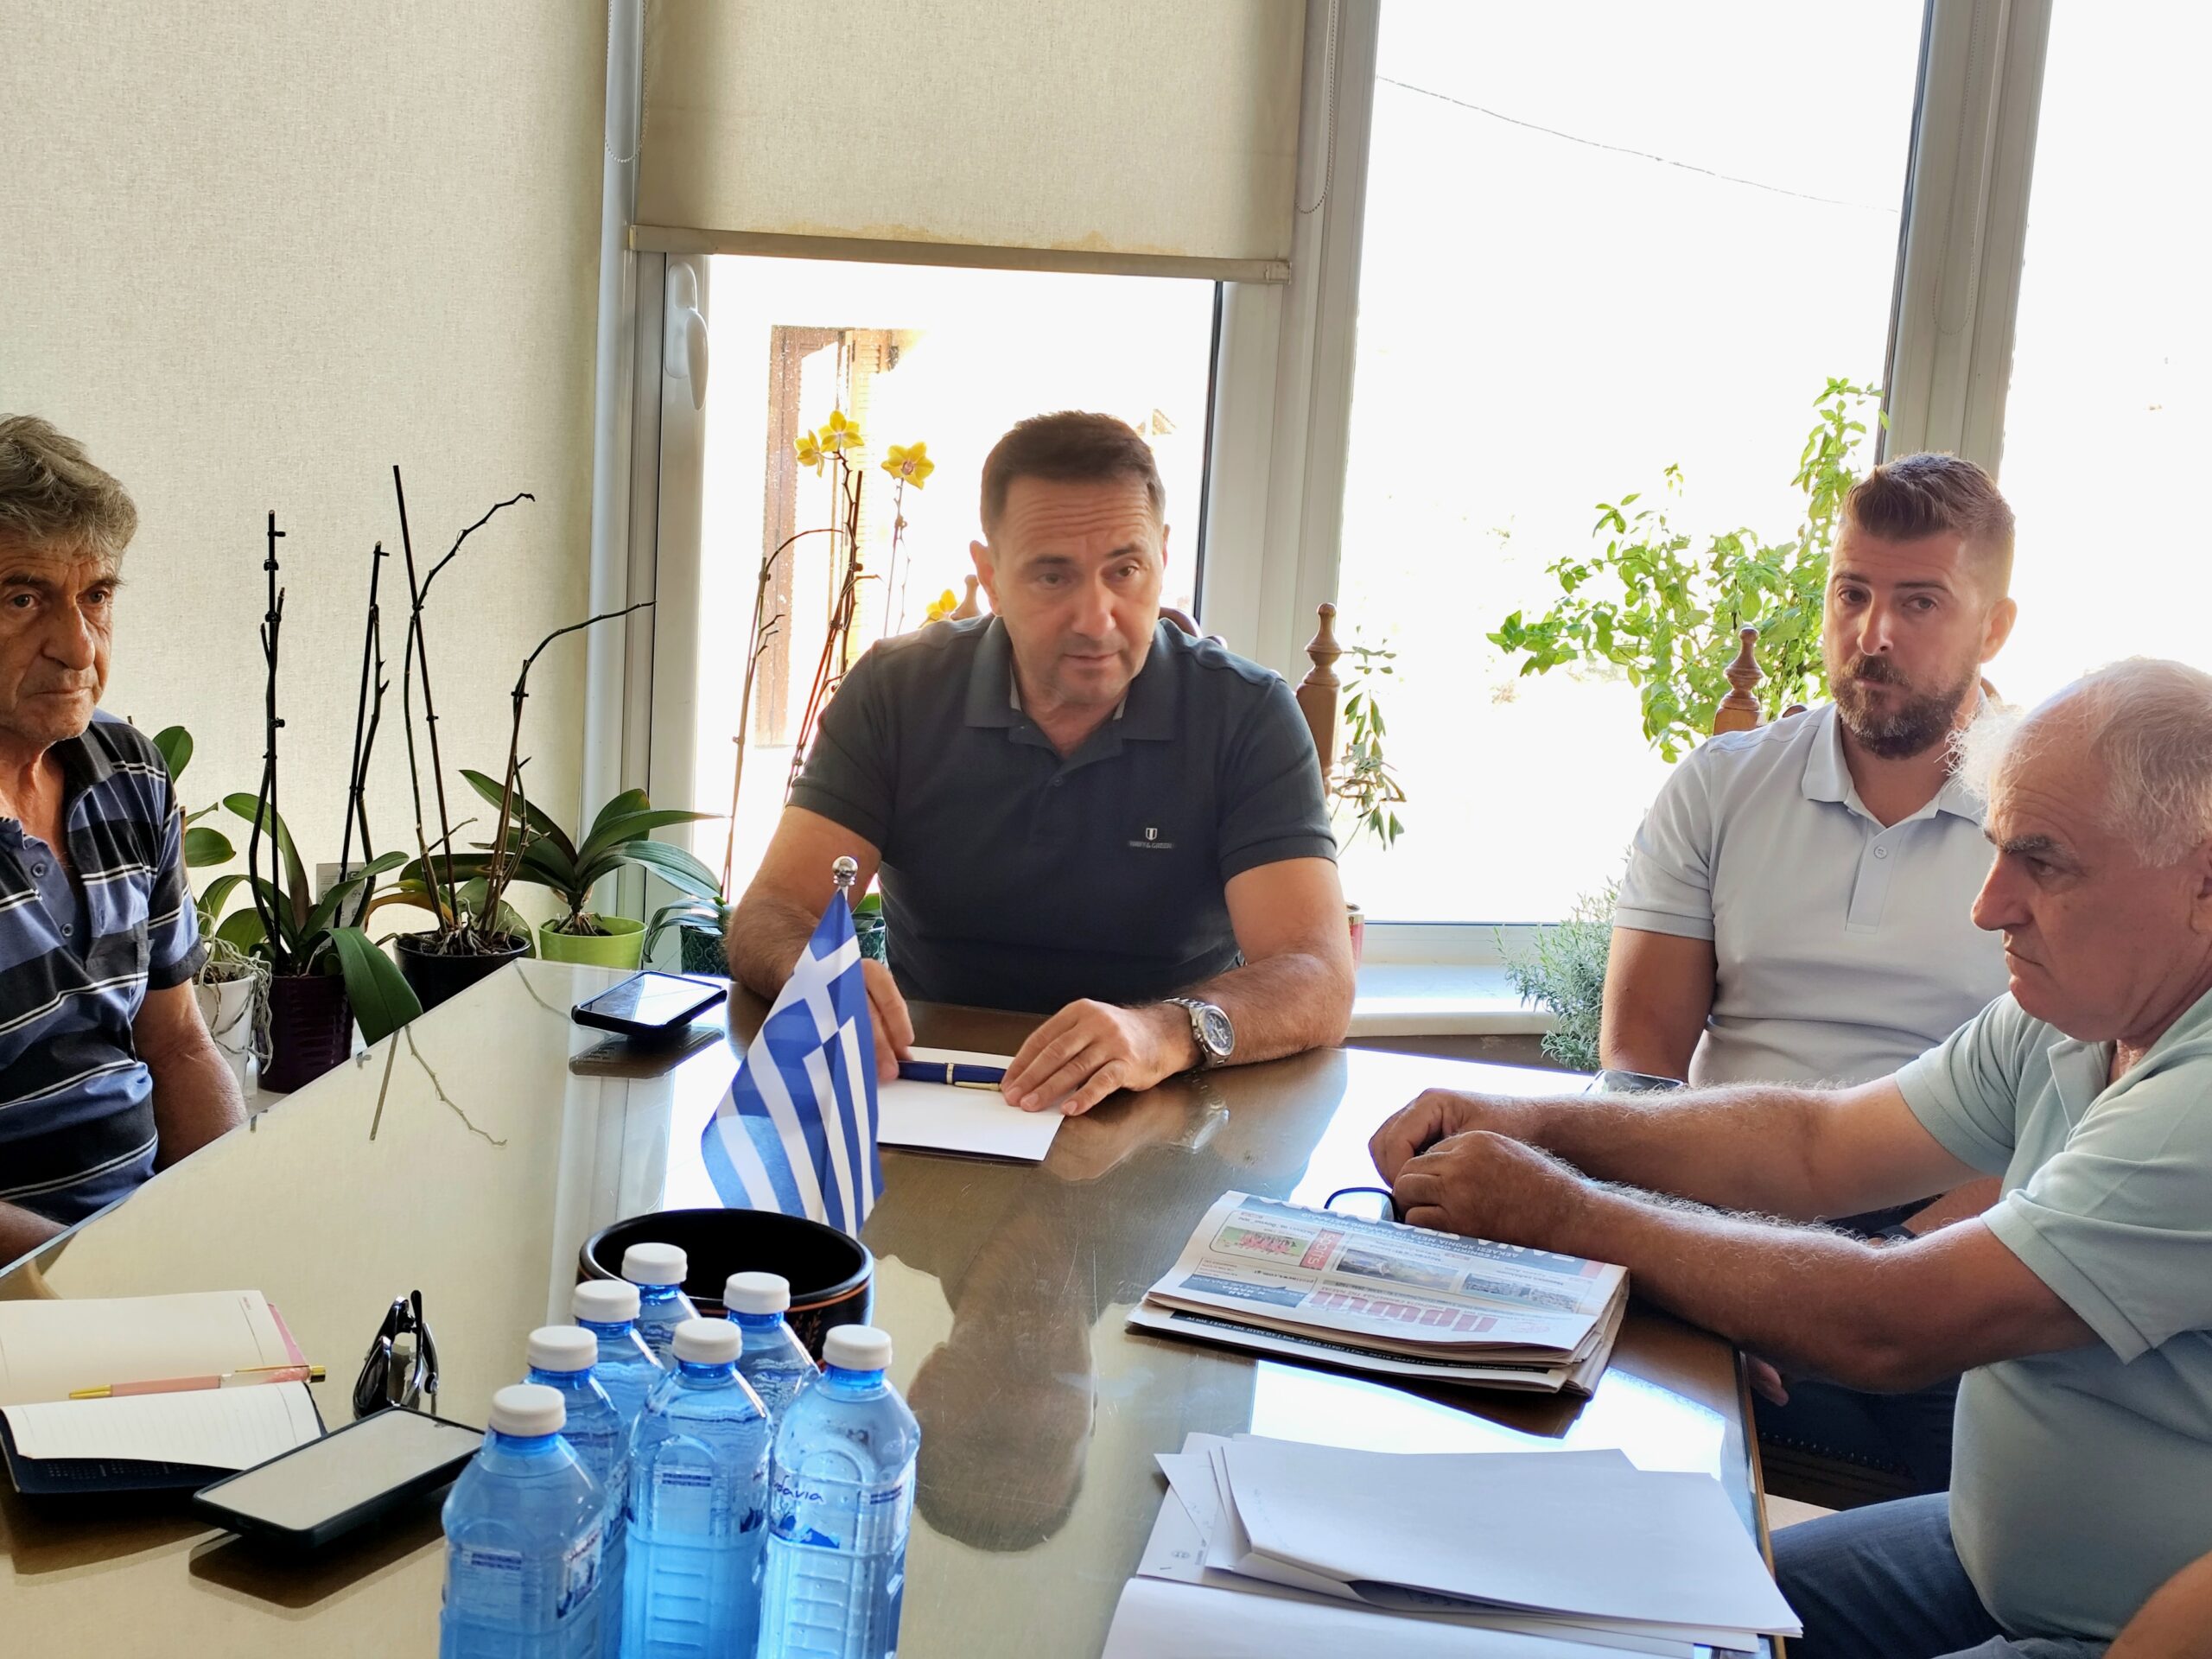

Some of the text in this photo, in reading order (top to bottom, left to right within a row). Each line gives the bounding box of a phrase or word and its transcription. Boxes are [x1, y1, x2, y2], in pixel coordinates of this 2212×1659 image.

[1300, 1212, 1349, 1226] ΜΕΤΑΛΛΙΟ
[1351, 1222, 1394, 1234] ΧΑΛΚΙΝΟ
[1408, 1233, 1436, 1243] ΜΕΤΑ
[1307, 1233, 1335, 1265] sports
[1415, 1240, 1451, 1249] ΟΜΑΔΑ
[1437, 1239, 1475, 1249] ΧΡΟΝΙΑ
[1452, 1247, 1491, 1257] ΕΘΝΙΚΗ
[1476, 1246, 1518, 1258] ΔΕΚΑΕΞΙ
